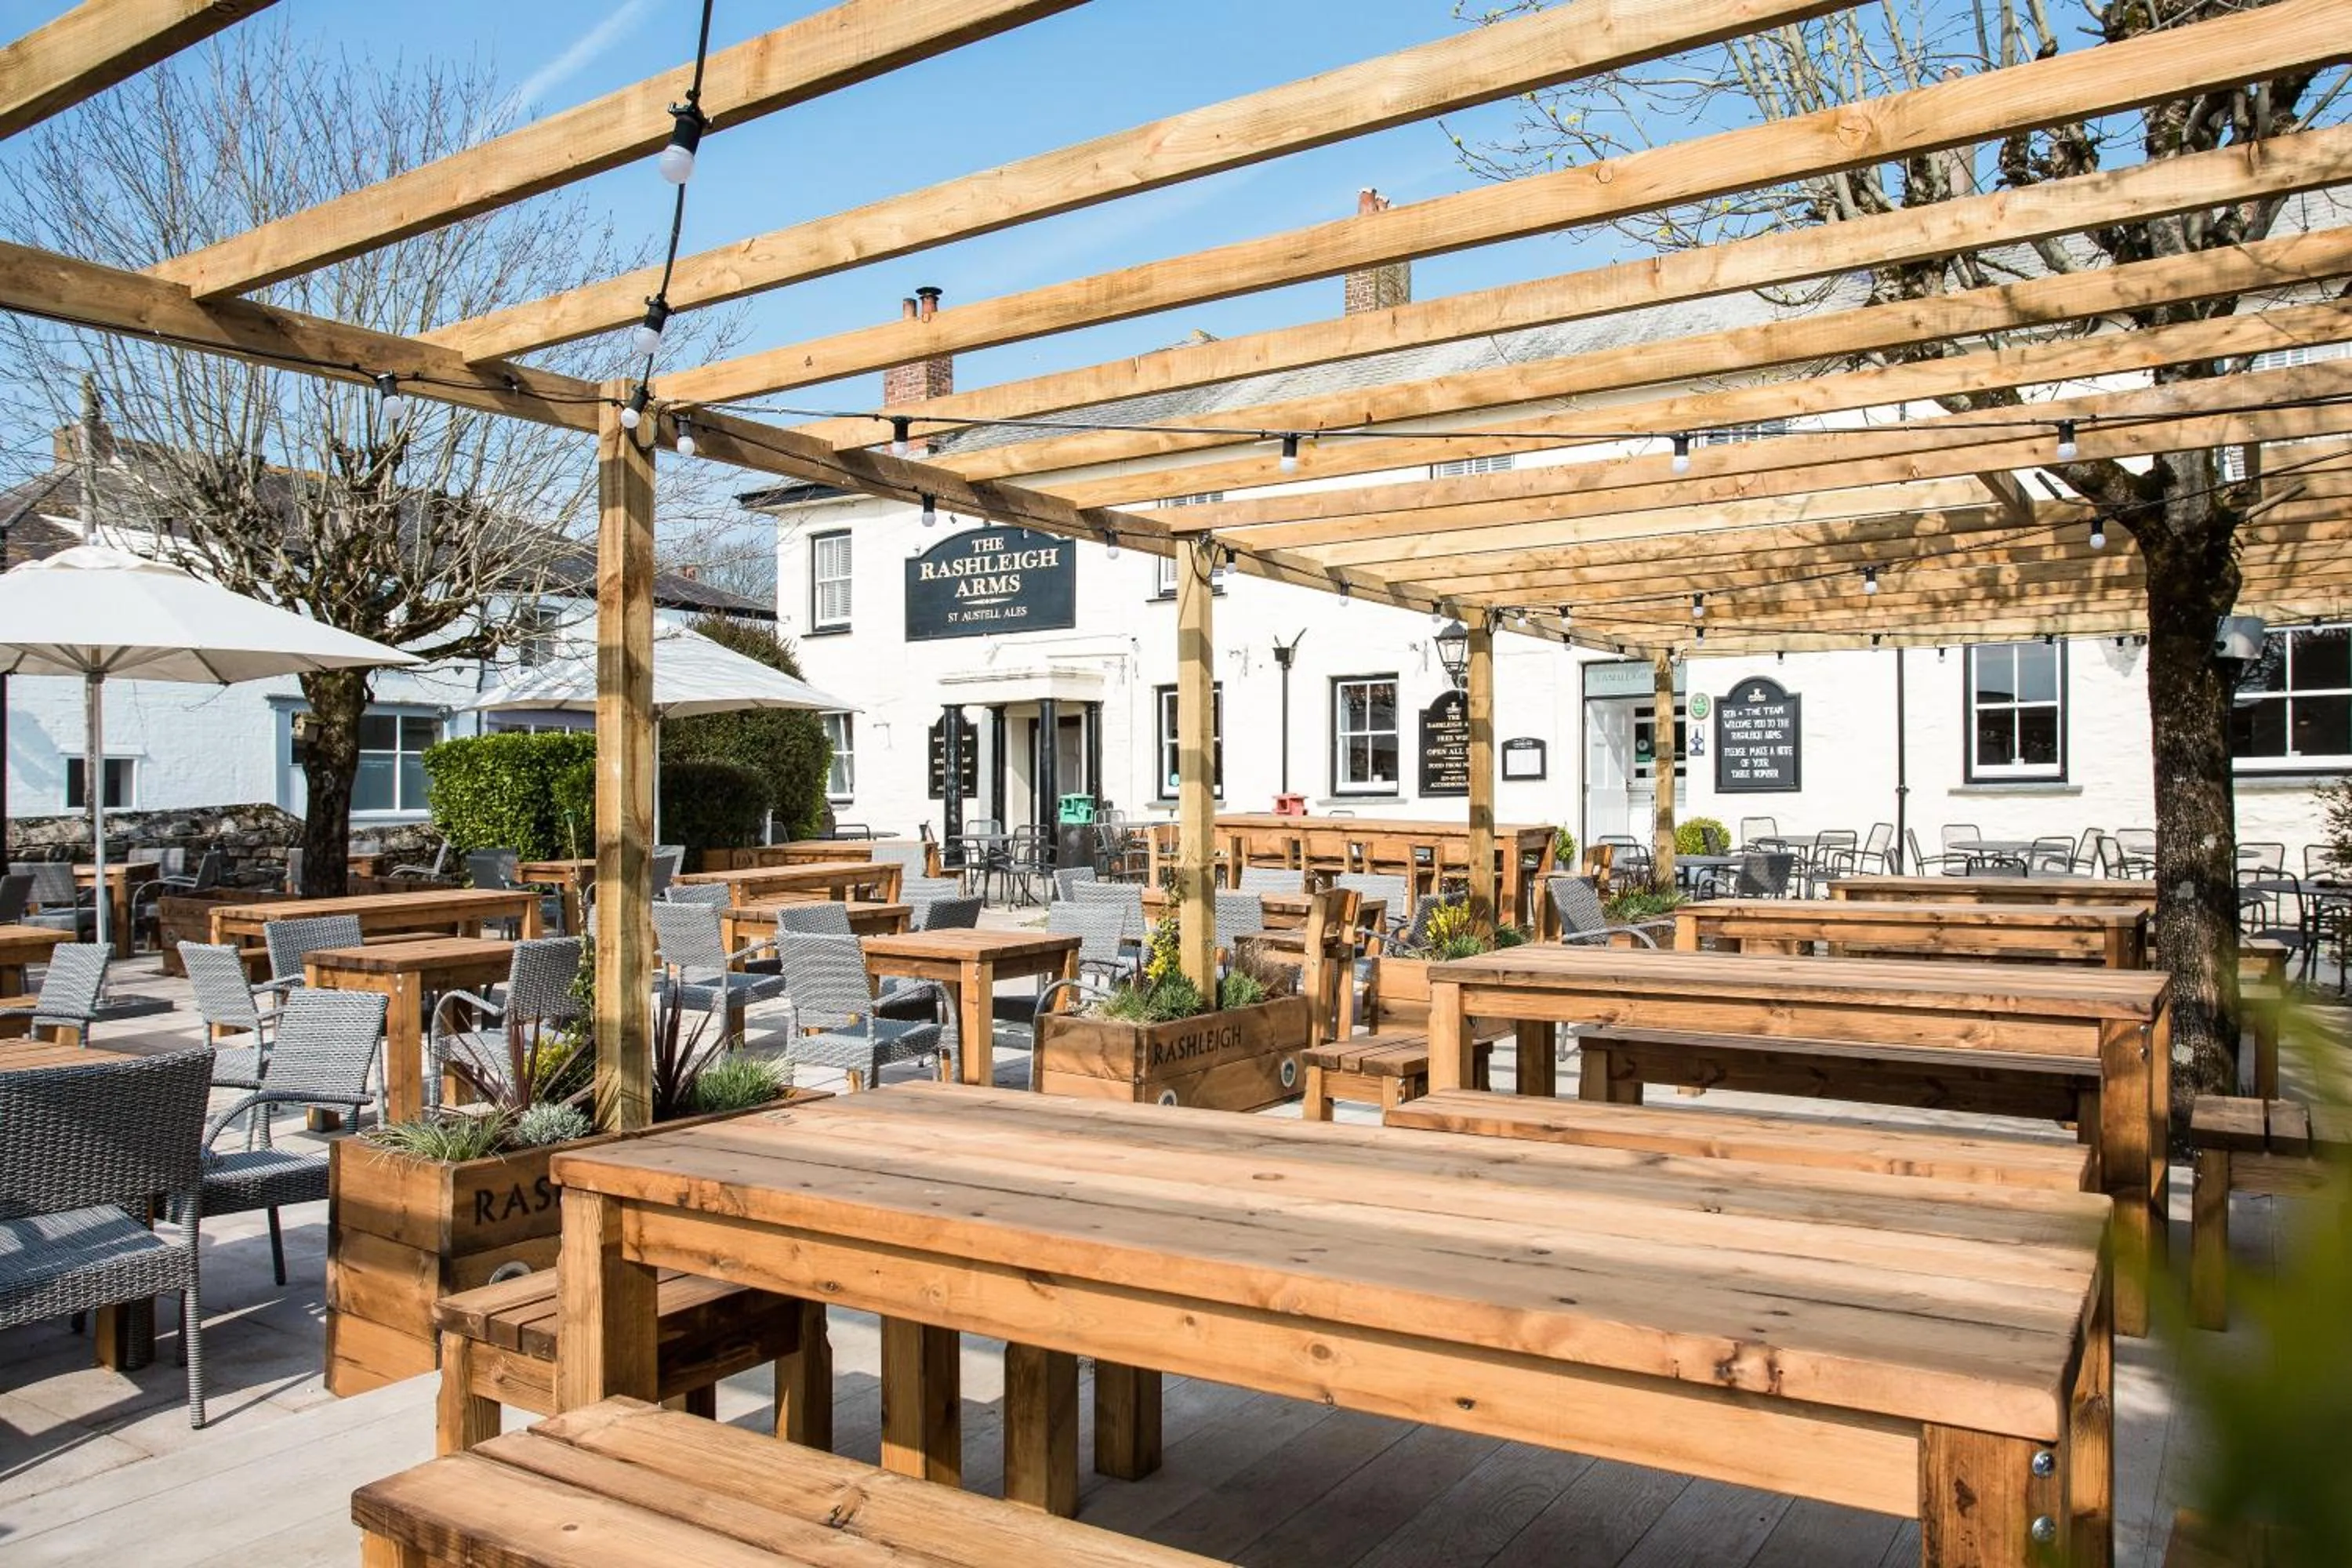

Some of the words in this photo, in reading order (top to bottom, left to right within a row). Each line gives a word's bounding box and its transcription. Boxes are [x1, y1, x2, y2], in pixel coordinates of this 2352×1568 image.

[971, 536, 1004, 554] THE
[919, 548, 1059, 581] RASHLEIGH
[954, 573, 1022, 598] ARMS
[948, 612, 960, 623] ST
[962, 608, 1001, 622] AUSTELL
[1004, 606, 1028, 618] ALES
[1426, 748, 1447, 757] OPEN
[1153, 1025, 1242, 1066] RASHLEIGH
